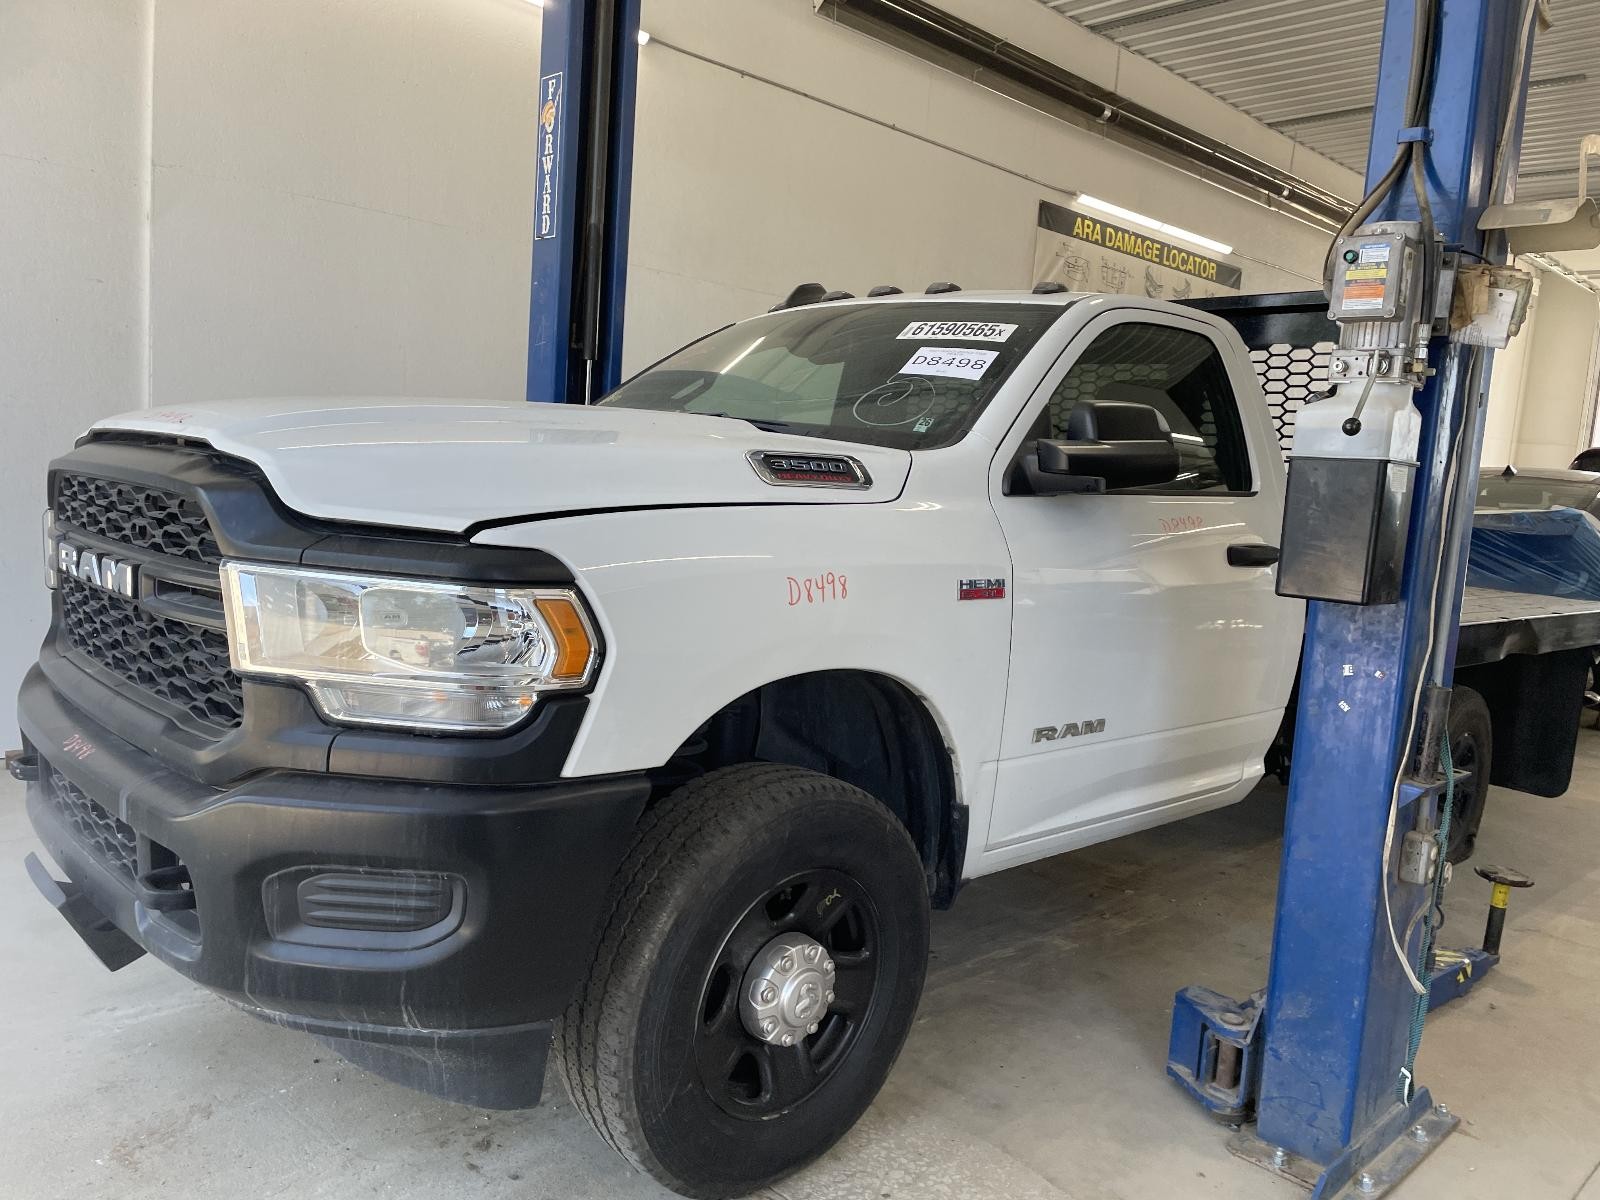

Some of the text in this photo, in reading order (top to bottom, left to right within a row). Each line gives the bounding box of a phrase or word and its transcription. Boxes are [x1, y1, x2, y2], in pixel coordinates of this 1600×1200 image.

[1073, 217, 1217, 281] ARA DAMAGE LOCATOR
[911, 355, 987, 370] D8498
[770, 459, 848, 473] 3500
[59, 542, 132, 597] RAM
[786, 572, 847, 606] D8498
[958, 578, 1006, 590] HEMI
[1031, 718, 1106, 744] RAM
